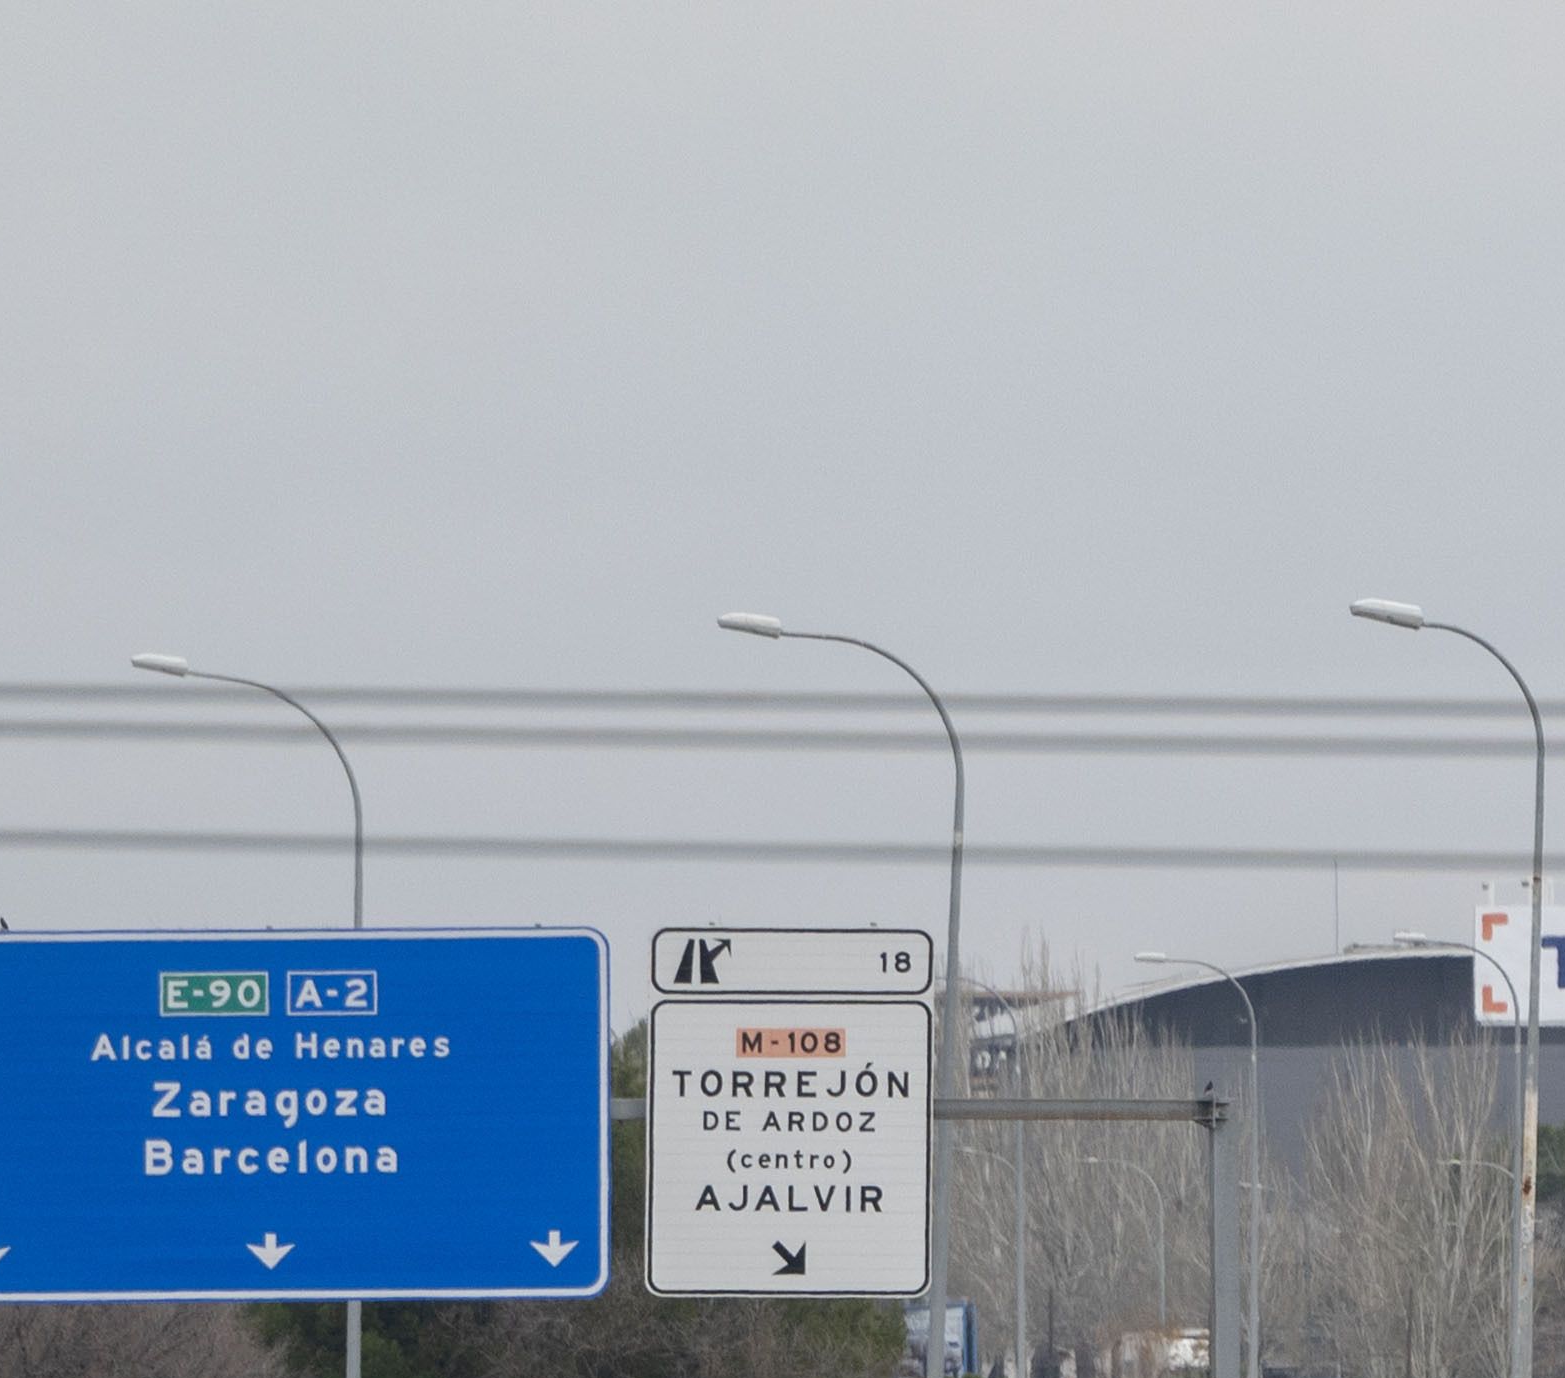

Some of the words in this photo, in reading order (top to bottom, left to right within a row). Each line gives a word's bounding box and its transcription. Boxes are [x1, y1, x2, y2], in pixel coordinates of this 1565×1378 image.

[880, 951, 911, 973] 18
[166, 979, 263, 1010] E-90
[295, 979, 369, 1010] A-2
[91, 1031, 212, 1062] Alcalá
[232, 1032, 273, 1061] de
[295, 1031, 451, 1060] Henares
[741, 1031, 841, 1055] M-108
[672, 1064, 910, 1099] TORREJÓN
[152, 1081, 387, 1129] Zaragoza
[701, 1109, 742, 1132] DE
[761, 1109, 877, 1134] ARDOZ
[144, 1139, 399, 1176] Barcelona
[725, 1147, 853, 1175] (centro)
[694, 1183, 884, 1214] AJALVIR
